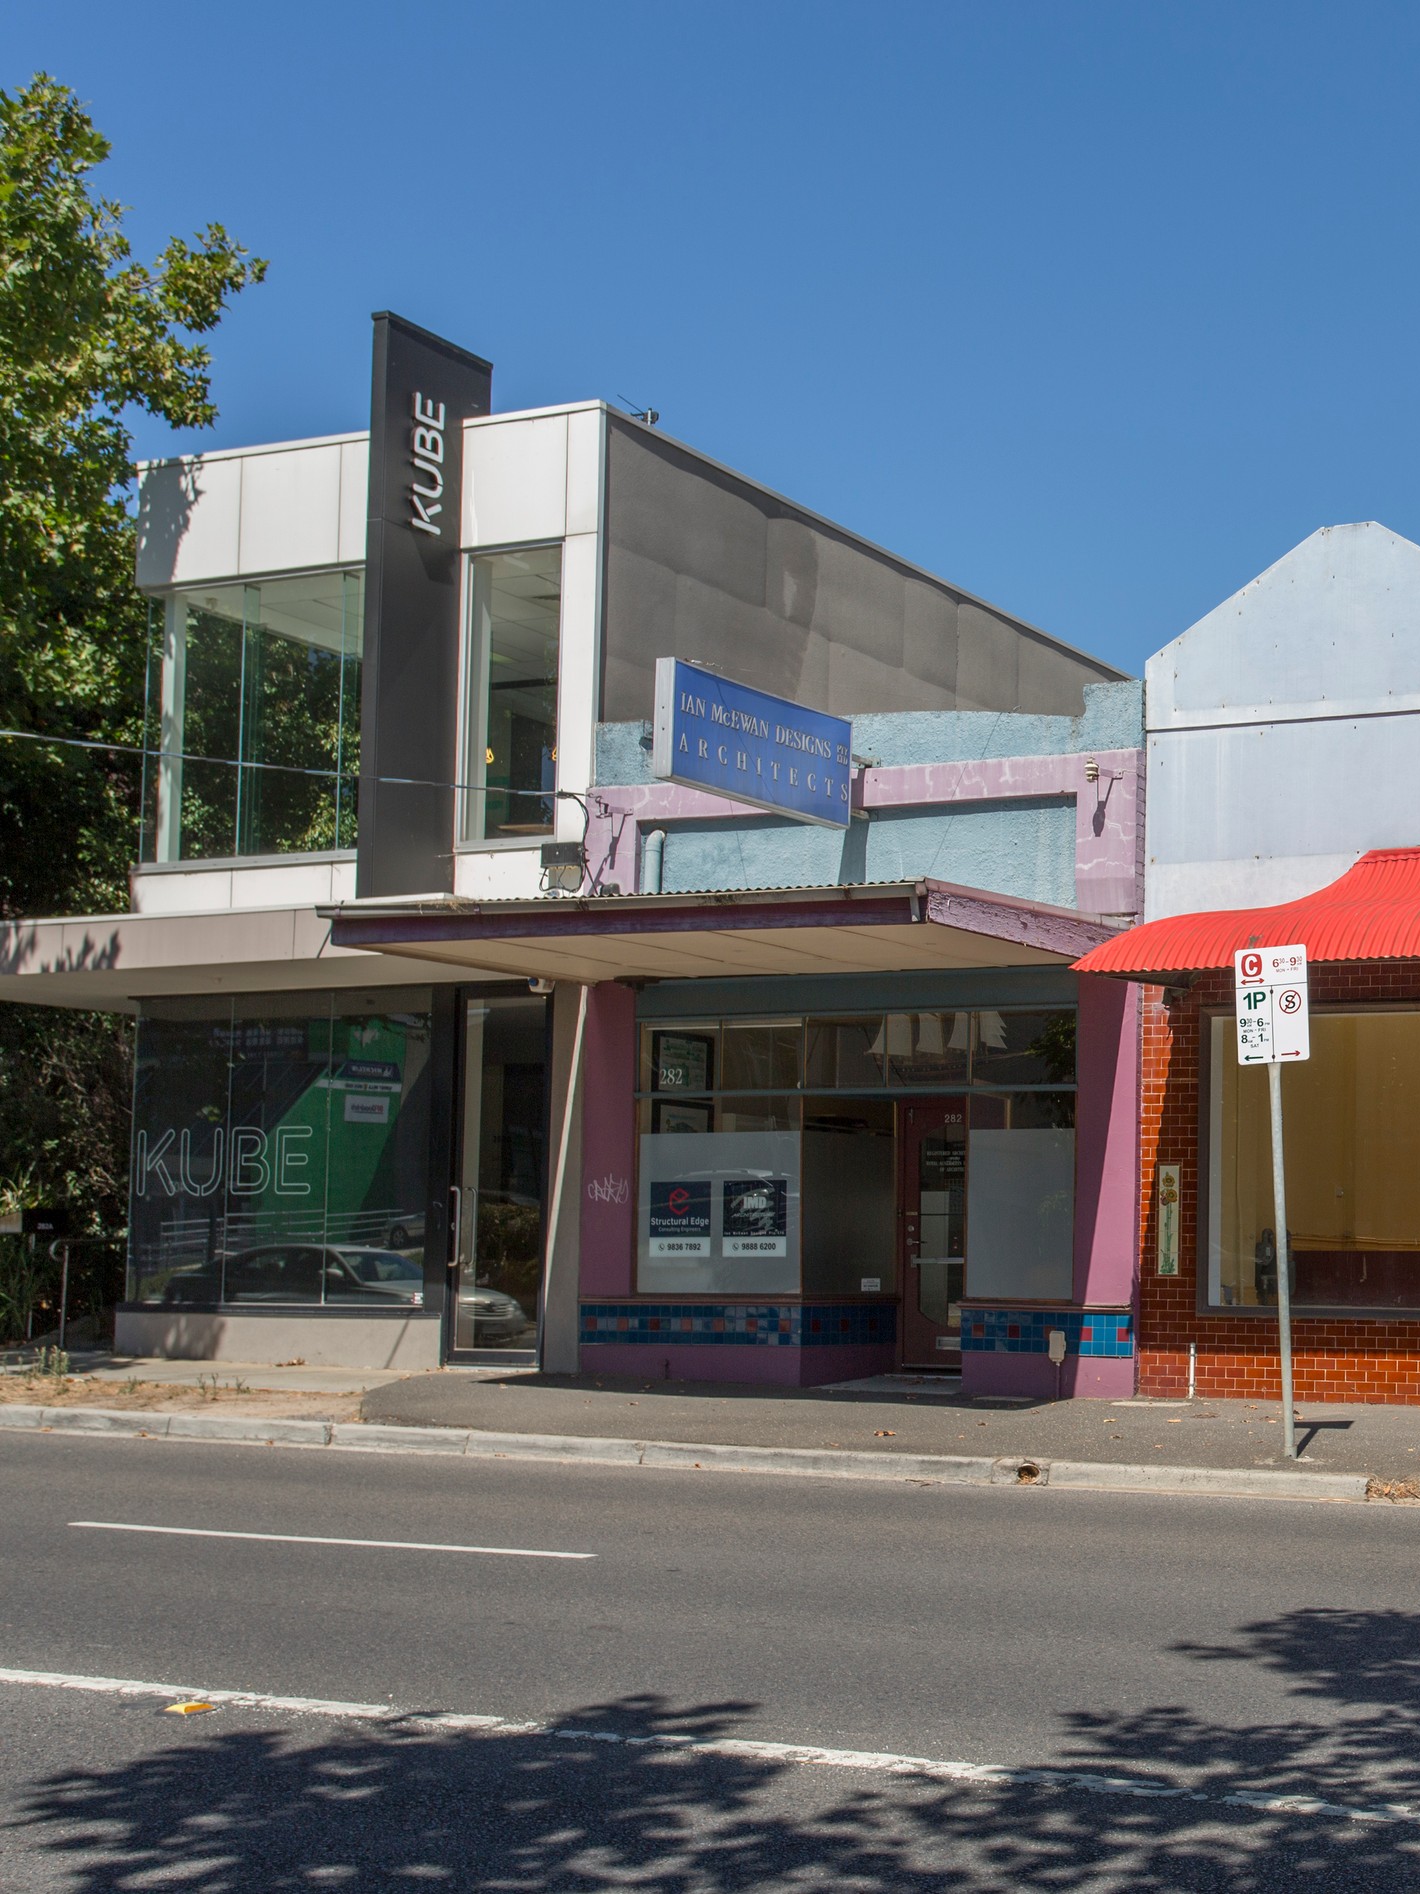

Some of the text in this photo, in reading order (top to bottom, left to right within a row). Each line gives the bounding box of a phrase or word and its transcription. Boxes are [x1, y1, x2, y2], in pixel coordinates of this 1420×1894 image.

[411, 391, 445, 536] KUBE
[681, 691, 706, 719] IAN
[775, 725, 832, 759] DESIGNS
[836, 744, 848, 755] PTY
[679, 733, 848, 801] ARCHITECTS
[1243, 992, 1266, 1010] 1P
[659, 1068, 683, 1085] 282
[944, 1114, 962, 1123] 282
[136, 1126, 313, 1197] KUBE
[743, 1196, 767, 1209] IMD
[651, 1217, 709, 1226] Structural Edge
[667, 1243, 701, 1251] 9836 7892
